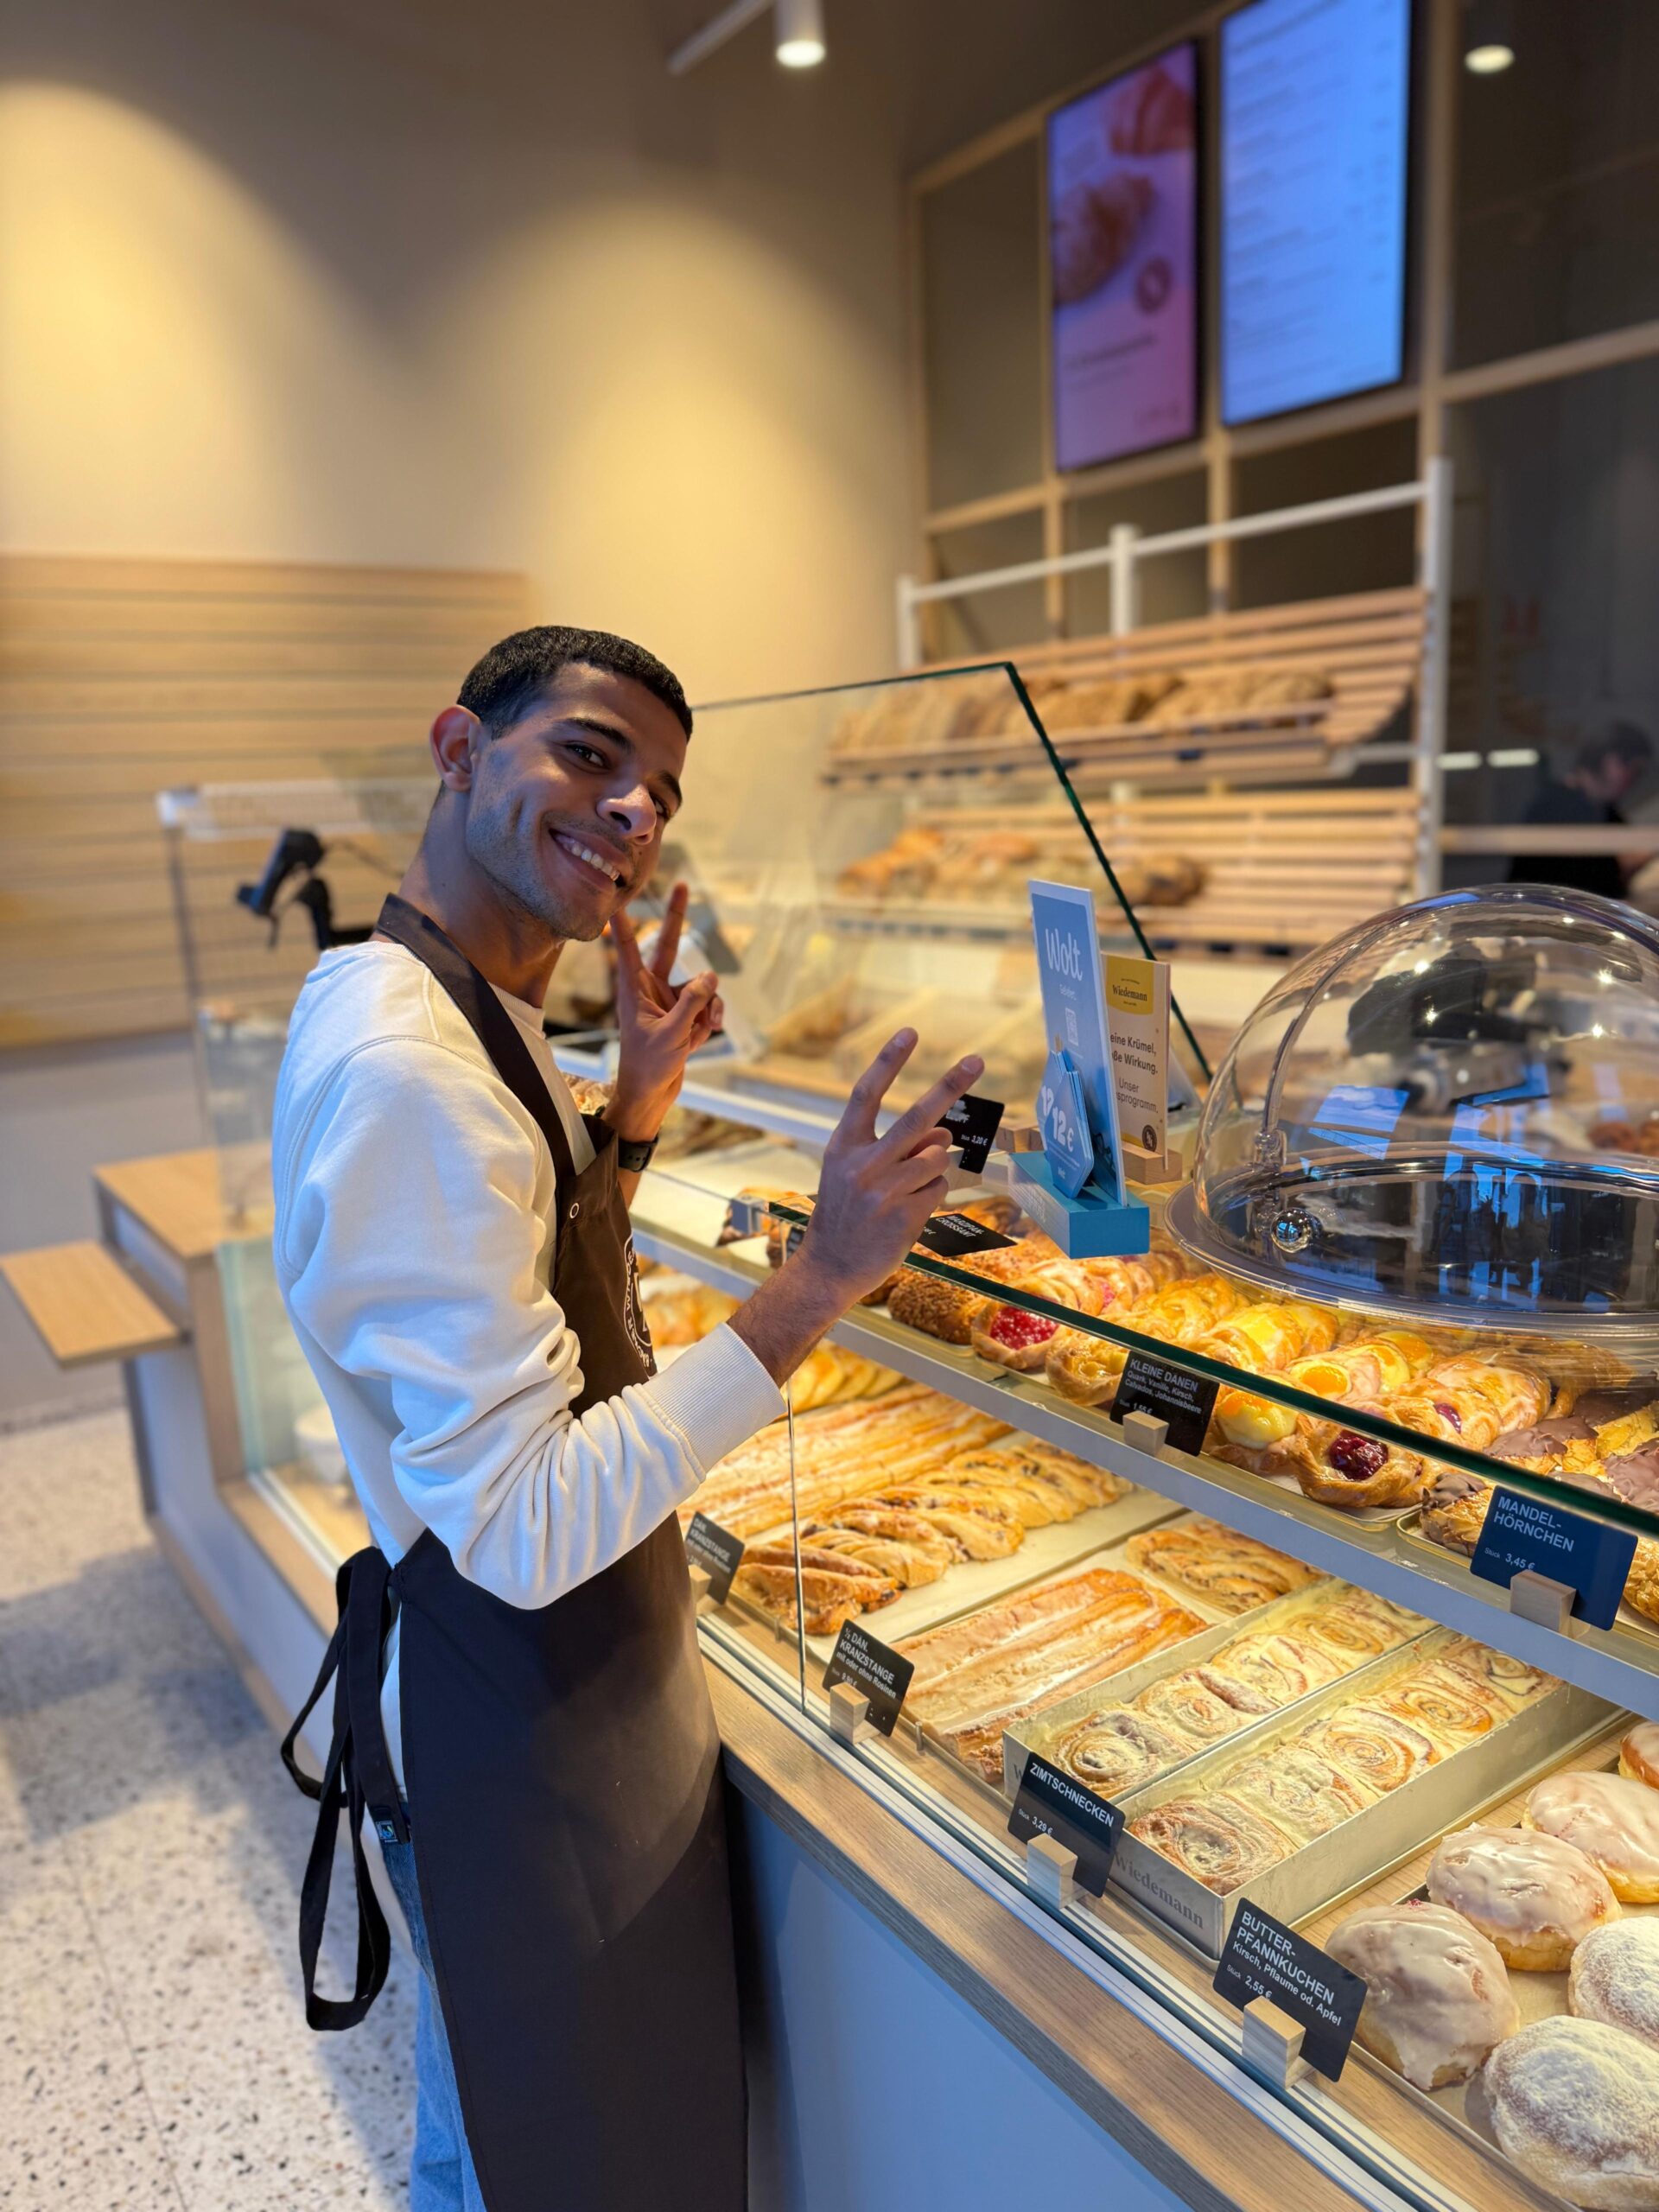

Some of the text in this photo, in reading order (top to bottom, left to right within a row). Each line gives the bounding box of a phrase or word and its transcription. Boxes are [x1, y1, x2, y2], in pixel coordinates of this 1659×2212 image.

[1045, 928, 1083, 982] Wolt
[1112, 984, 1147, 1001] Wiedemann
[1110, 1033, 1157, 1056] eine Krümel,
[1111, 1051, 1158, 1075] ße Wirkung.
[1118, 1077, 1140, 1093] Unser
[1116, 1092, 1158, 1113] sprogramm.
[935, 1217, 976, 1236] CROISSANT
[1127, 1370, 1194, 1402] Quark, Vanille, Kirsch,
[1130, 1359, 1166, 1379] KLEINE
[1125, 1378, 1202, 1414] Calvados, Johannisbeere
[1497, 1496, 1562, 1529] MANDEL-
[1493, 1510, 1574, 1552] HÖRNCHEN
[1505, 1553, 1526, 1569] 3,45
[1528, 1562, 1535, 1571] €
[836, 1651, 897, 1699] mit oder ohne Rosinen
[839, 1640, 895, 1684] KRANZSTANGE
[1029, 1763, 1115, 1828] ZIMTSCHNECKEN
[1032, 1815, 1047, 1834] 3,29
[1047, 1827, 1053, 1836] €
[1114, 1852, 1205, 1929] Wiedemann
[1241, 1910, 1296, 1956] BUTTER-
[1227, 1964, 1273, 2000] Stück 2,55 €
[1236, 1926, 1335, 2005] PFANNKUCHEN
[1232, 1941, 1341, 2026] Kirsch, Pflaume od. Apfel
